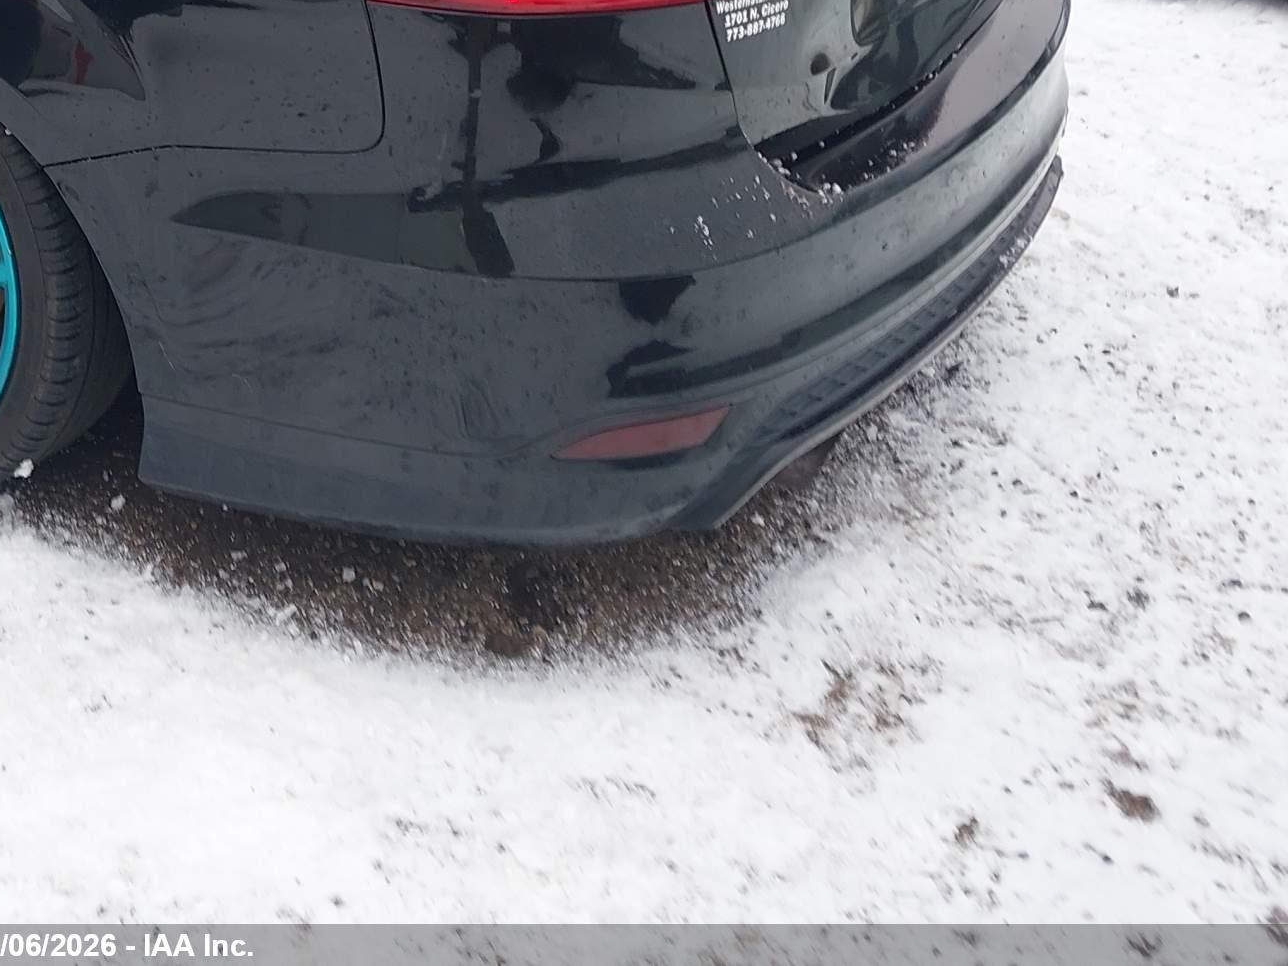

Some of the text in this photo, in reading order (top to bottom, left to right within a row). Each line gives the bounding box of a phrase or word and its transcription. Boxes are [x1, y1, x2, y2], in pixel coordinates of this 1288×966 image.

[724, 0, 789, 28] 1701 N. Cicero
